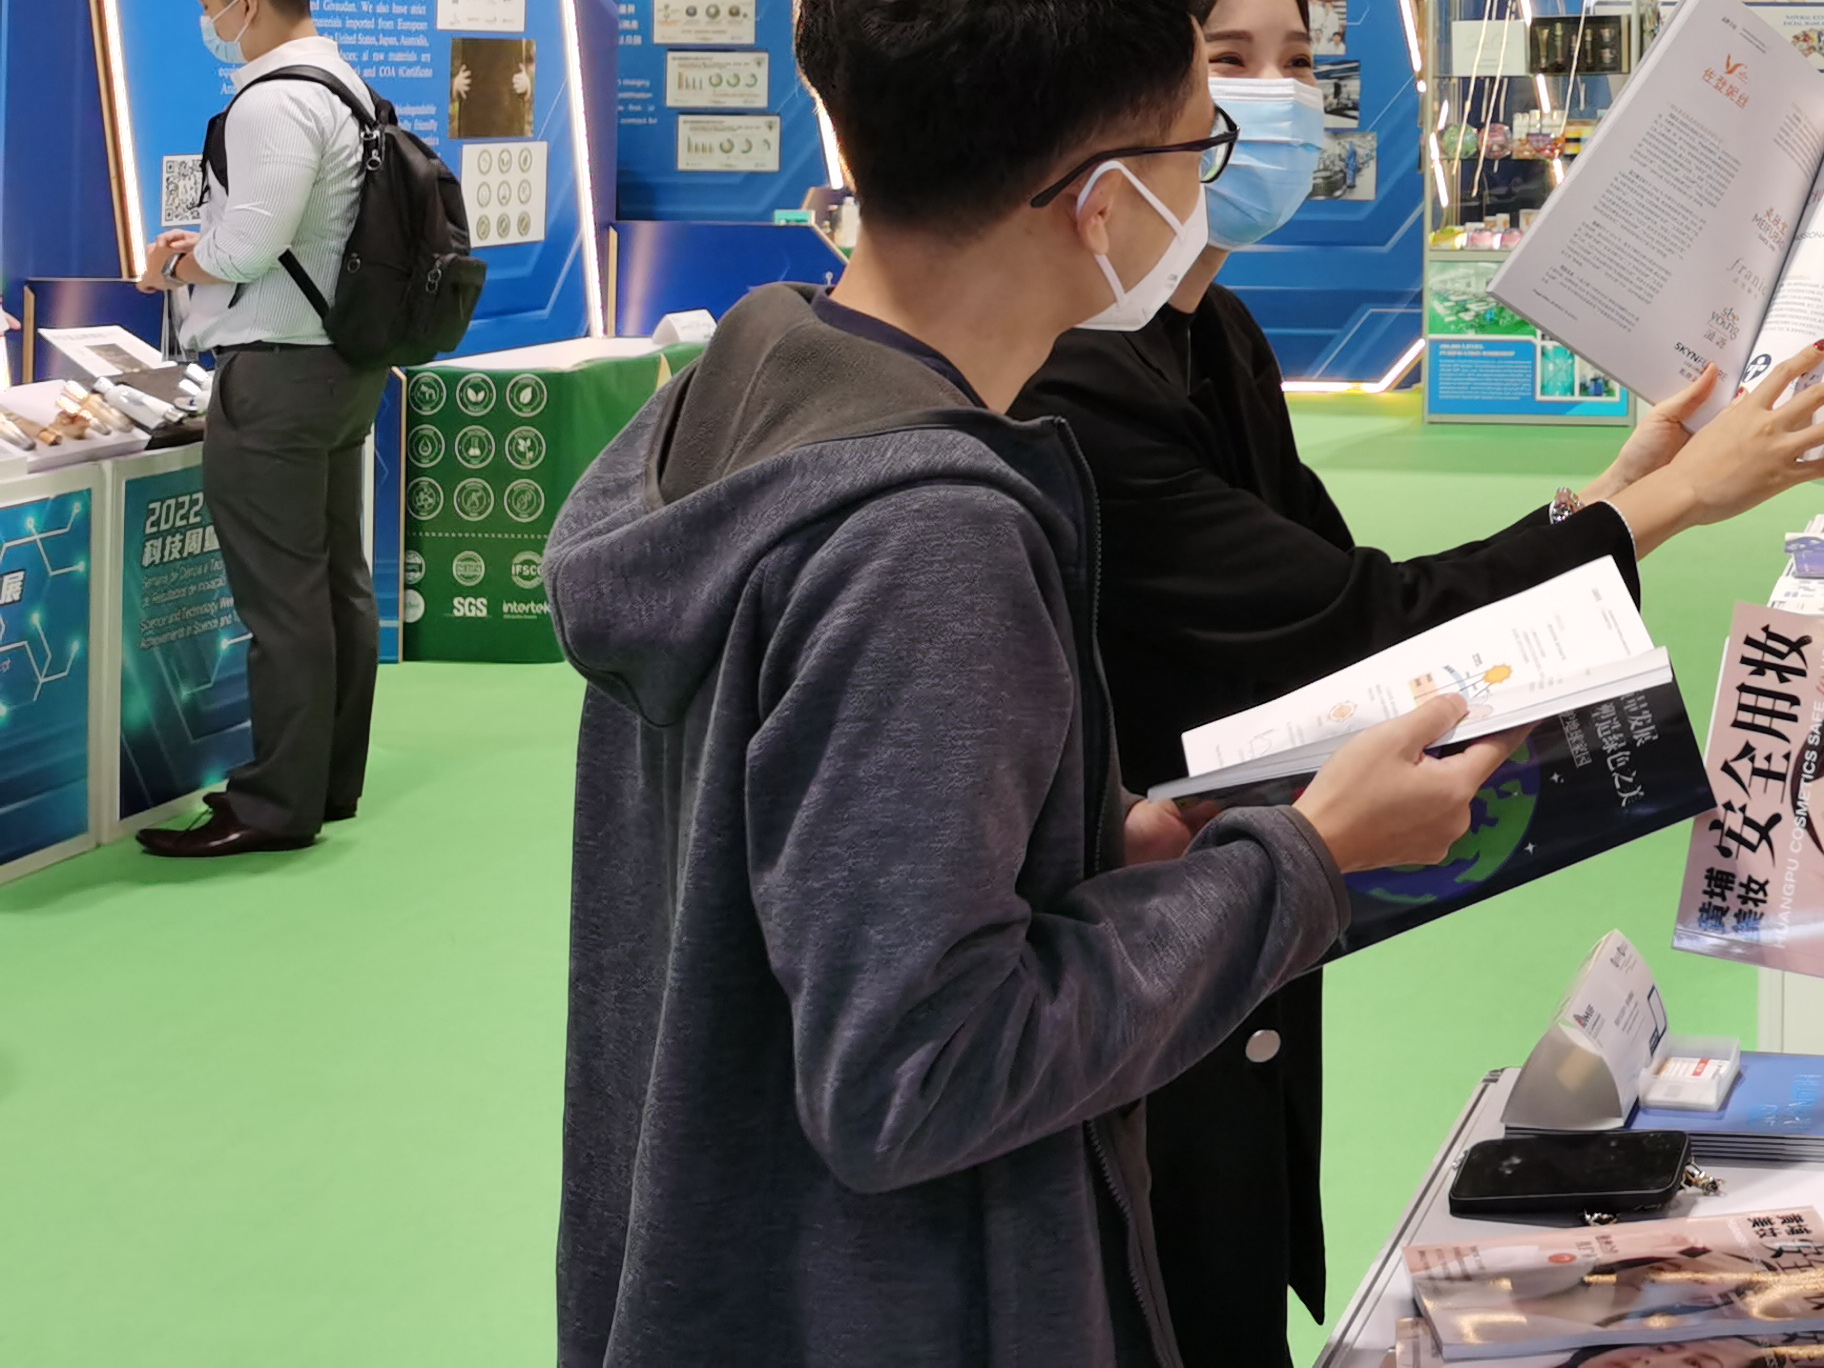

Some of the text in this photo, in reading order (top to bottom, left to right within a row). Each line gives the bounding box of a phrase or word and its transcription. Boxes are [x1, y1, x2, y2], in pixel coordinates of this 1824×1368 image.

[145, 491, 204, 535] 2022
[453, 596, 488, 617] SGS
[1708, 623, 1814, 868] 安全用妆
[1790, 749, 1819, 854] COSMETICS
